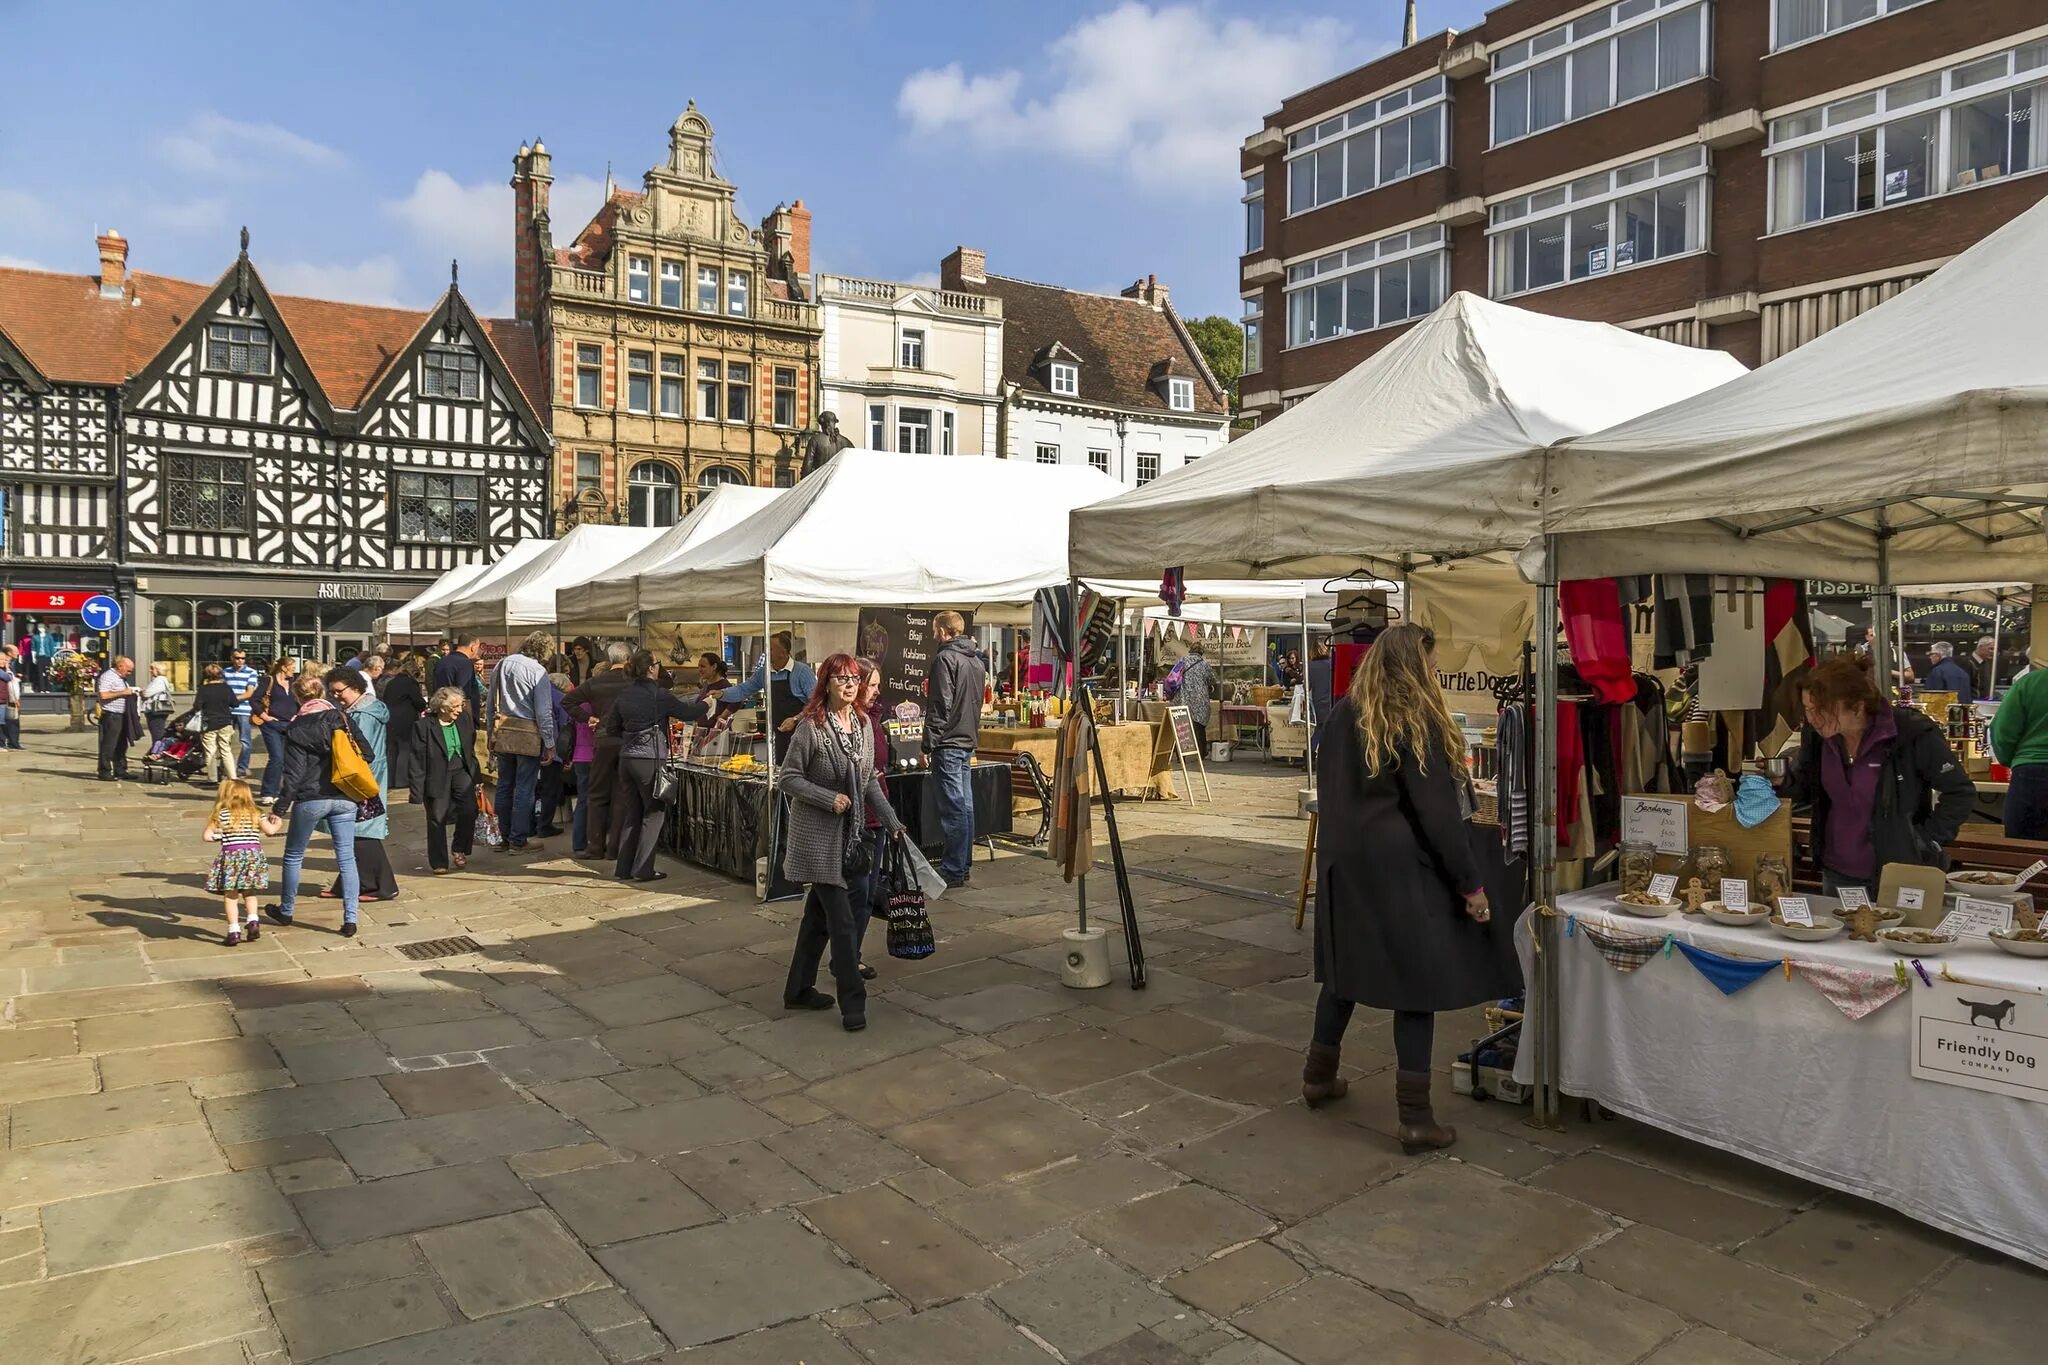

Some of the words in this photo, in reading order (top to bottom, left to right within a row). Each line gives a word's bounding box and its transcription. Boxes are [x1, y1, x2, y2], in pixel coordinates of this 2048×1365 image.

[318, 583, 340, 599] ASK
[341, 583, 383, 600] ITALIAN
[49, 596, 65, 606] 25
[906, 613, 927, 626] Samosa
[1963, 604, 2017, 630] VALEIE
[908, 629, 923, 645] Bhaji
[889, 678, 904, 690] Fresh
[904, 680, 920, 697] Curry
[1437, 669, 1475, 691] urtle
[1633, 801, 1672, 816] Bandanas
[1977, 1035, 1995, 1044] THE
[1937, 1038, 2000, 1062] Friendly
[2005, 1050, 2036, 1069] Dog
[1961, 1059, 2010, 1073] COMPANY
